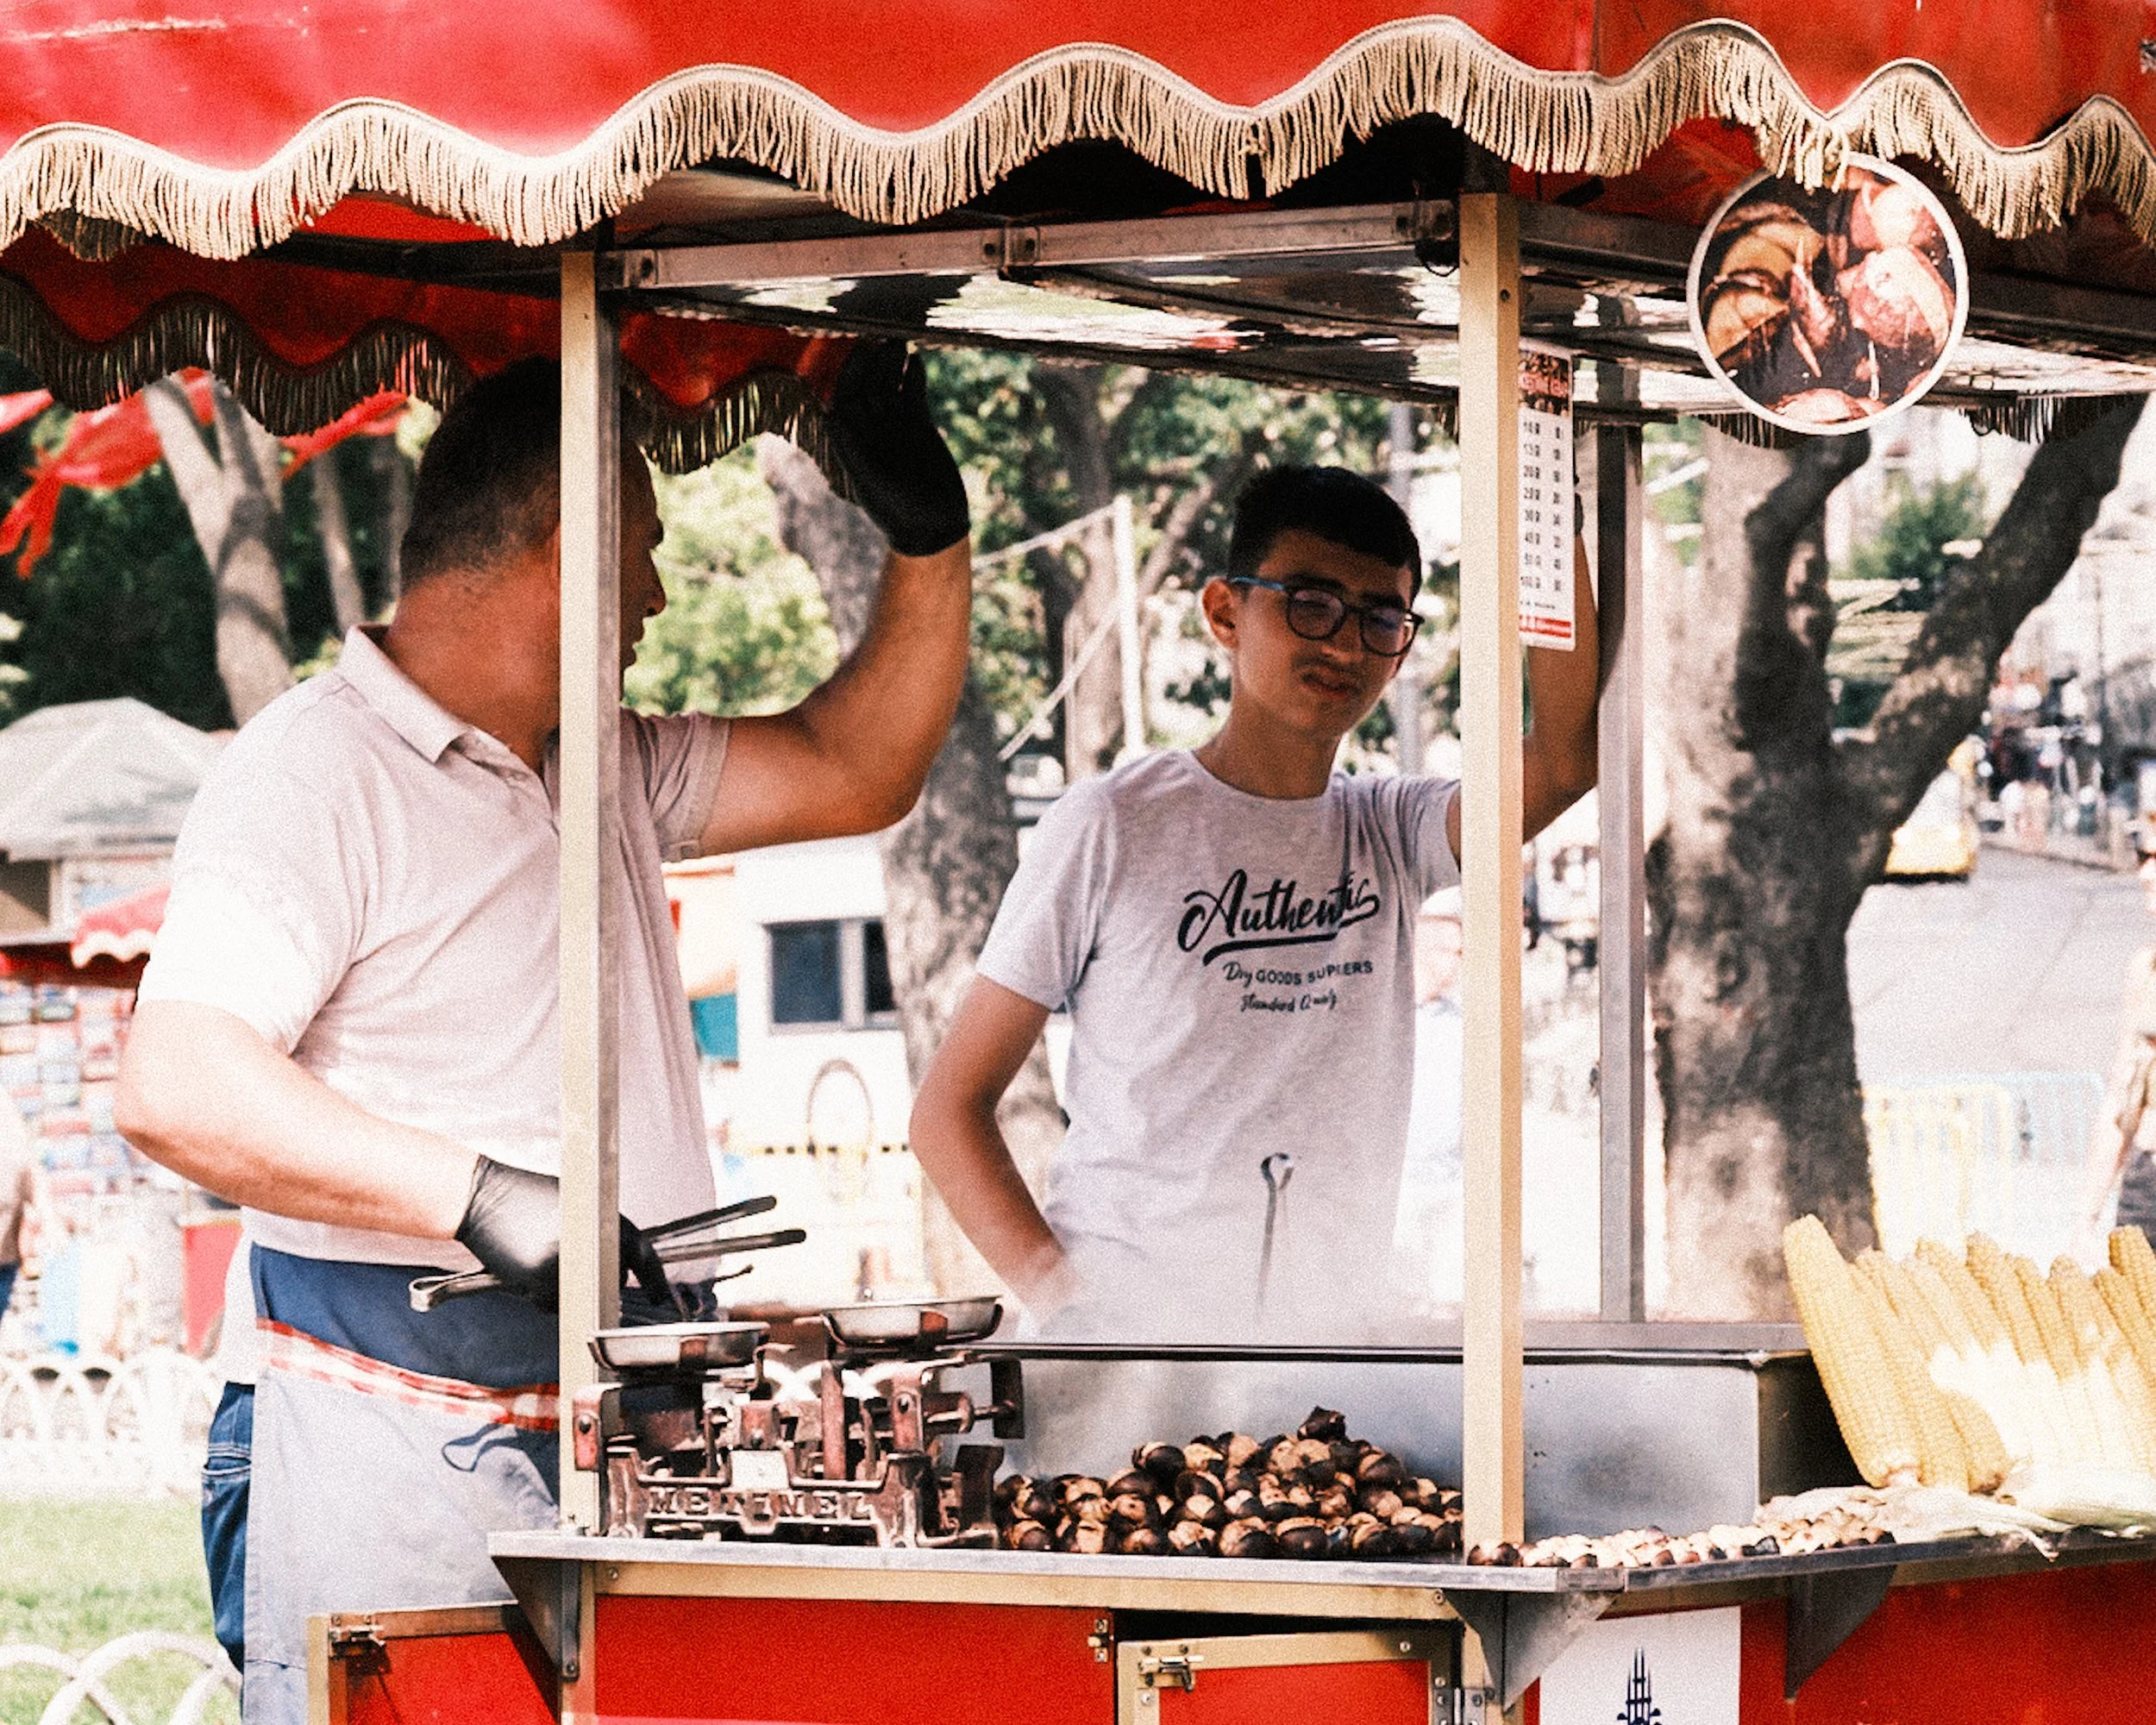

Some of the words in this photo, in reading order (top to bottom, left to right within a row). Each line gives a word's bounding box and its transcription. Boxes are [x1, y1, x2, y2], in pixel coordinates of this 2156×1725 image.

[1177, 869, 1380, 956] Authentic
[1222, 961, 1253, 988] Dry
[1256, 968, 1302, 986] GOODS
